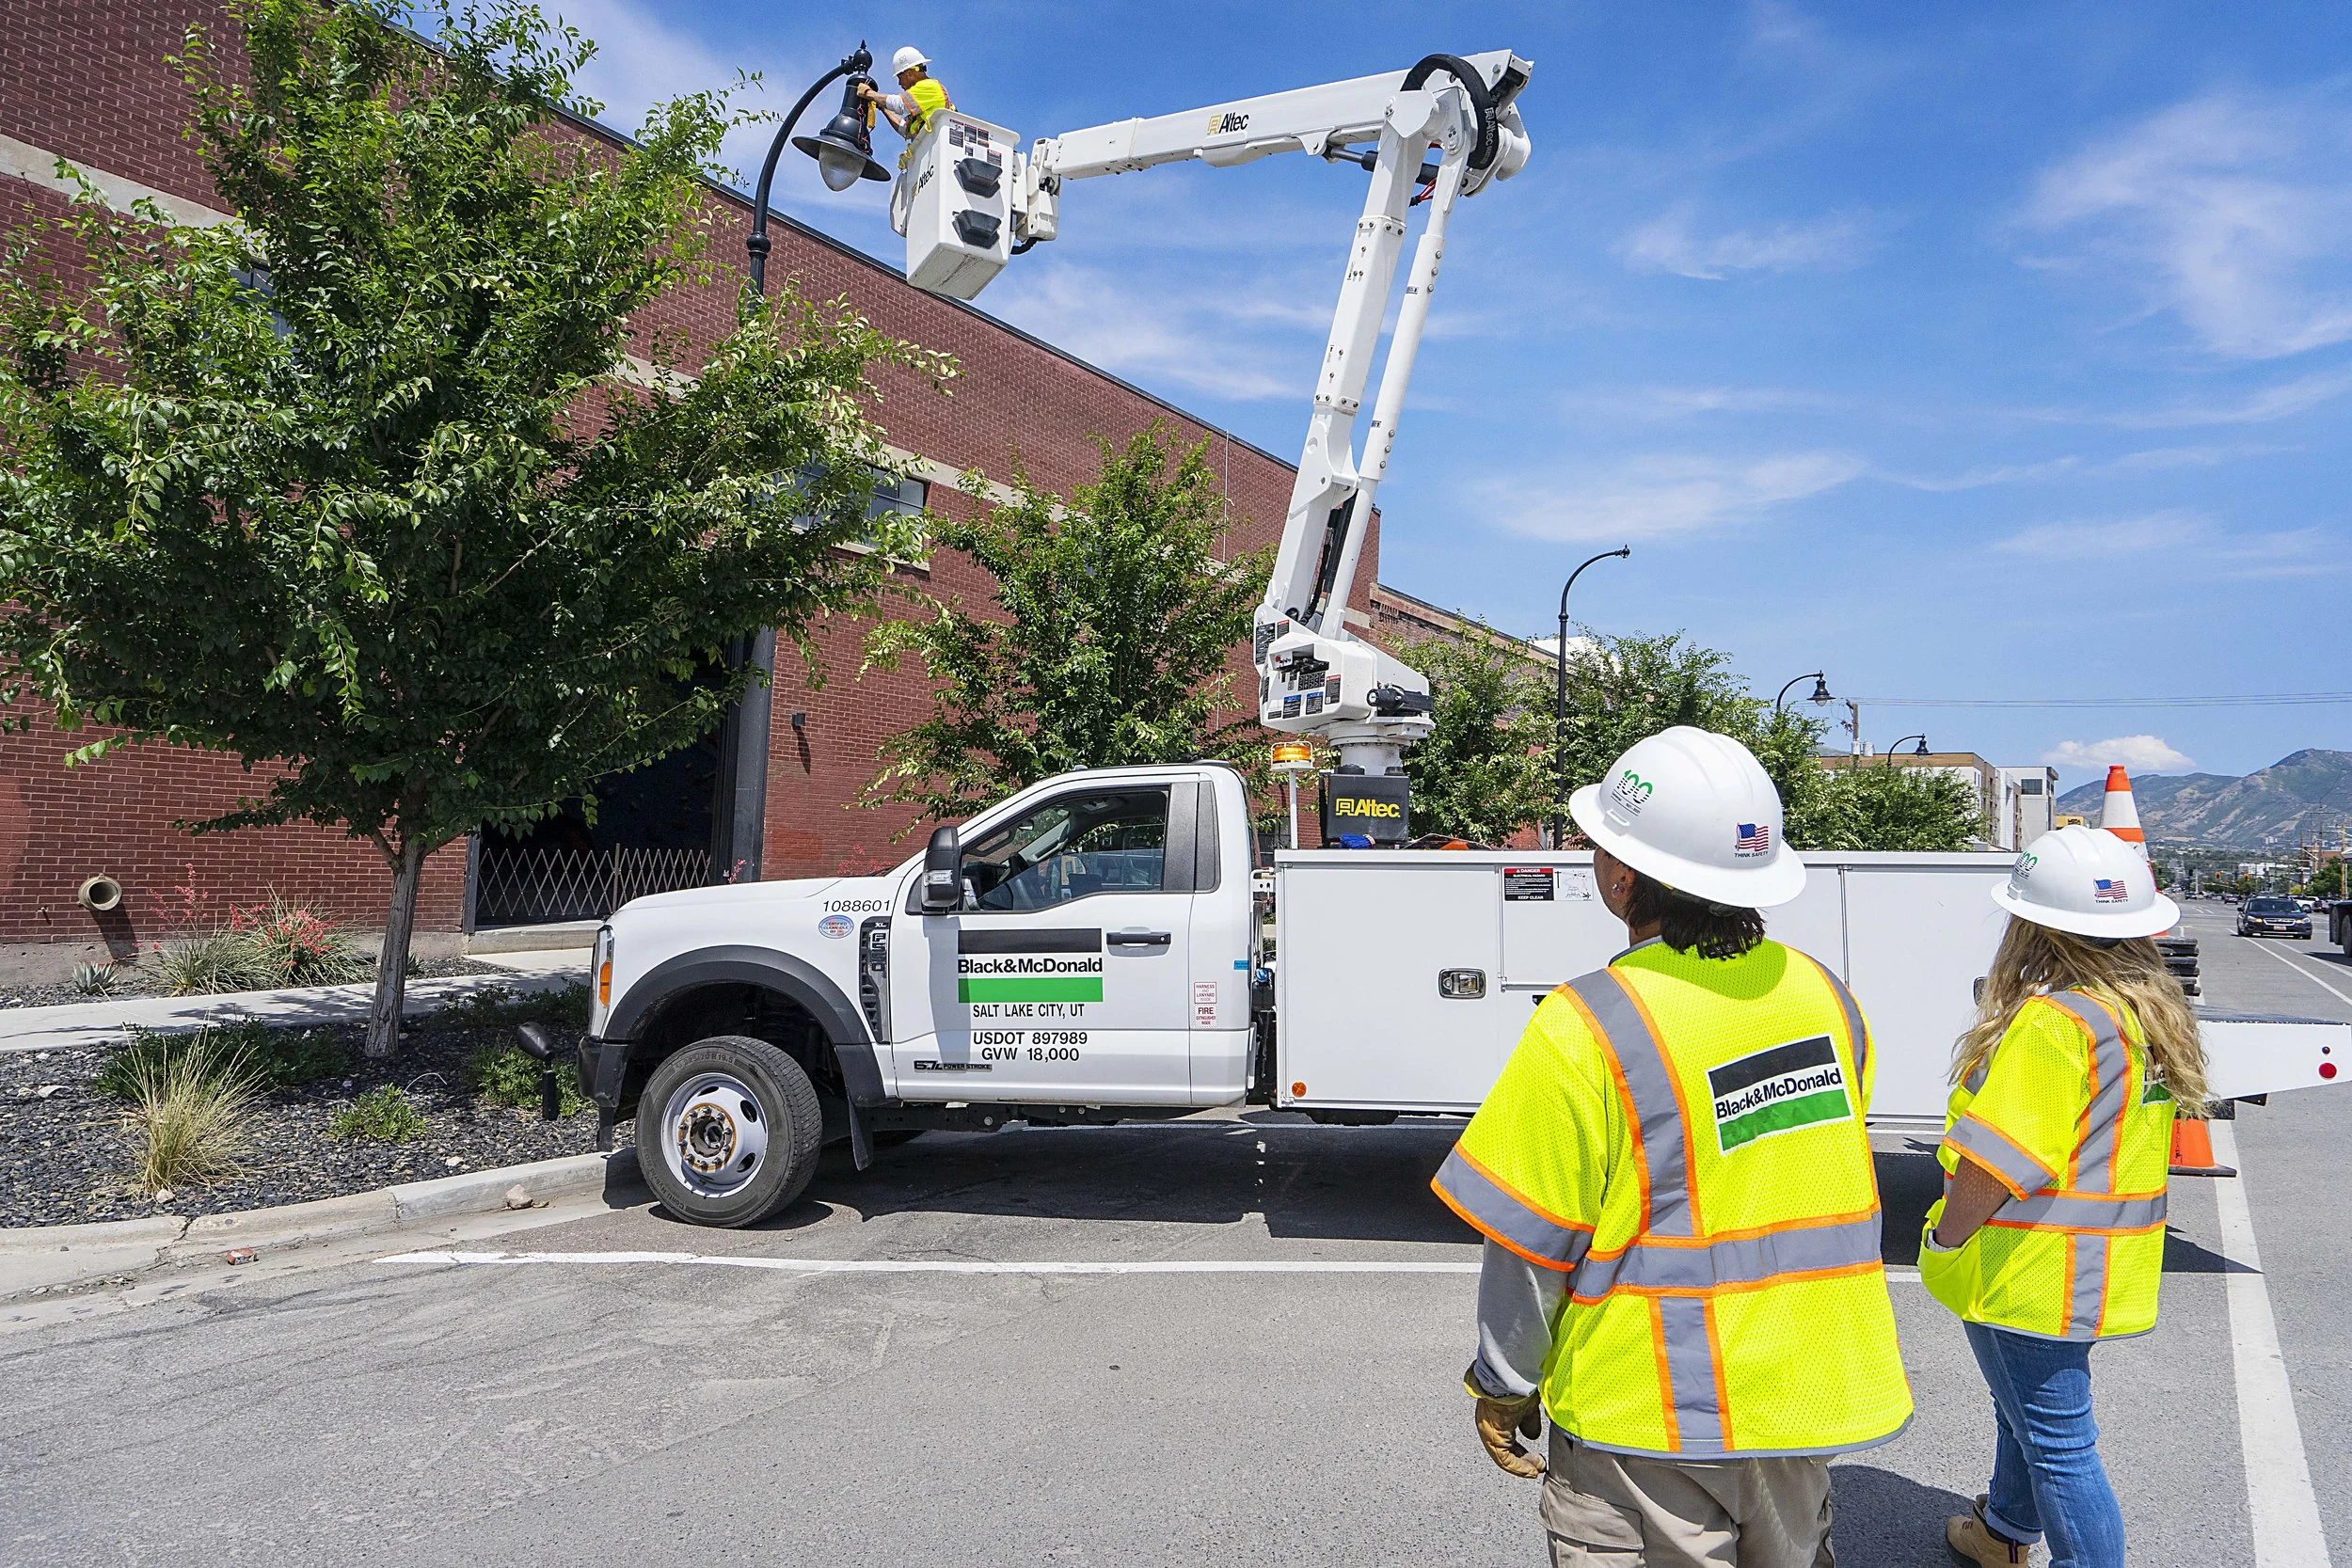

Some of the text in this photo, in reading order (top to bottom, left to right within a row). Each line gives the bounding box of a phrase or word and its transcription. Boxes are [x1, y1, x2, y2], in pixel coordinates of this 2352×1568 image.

[1218, 112, 1249, 134] Altec
[917, 165, 934, 194] Altec
[1355, 799, 1400, 817] Altec
[823, 899, 890, 912] 1088601
[958, 957, 1103, 974] Black&McDonald
[973, 1004, 1085, 1020] SALT LAKE CITY, UT
[973, 1032, 1089, 1045] USDOT 897989
[981, 1047, 1080, 1063] GVW 18,000
[1714, 1067, 1843, 1120] Black&McDonald
